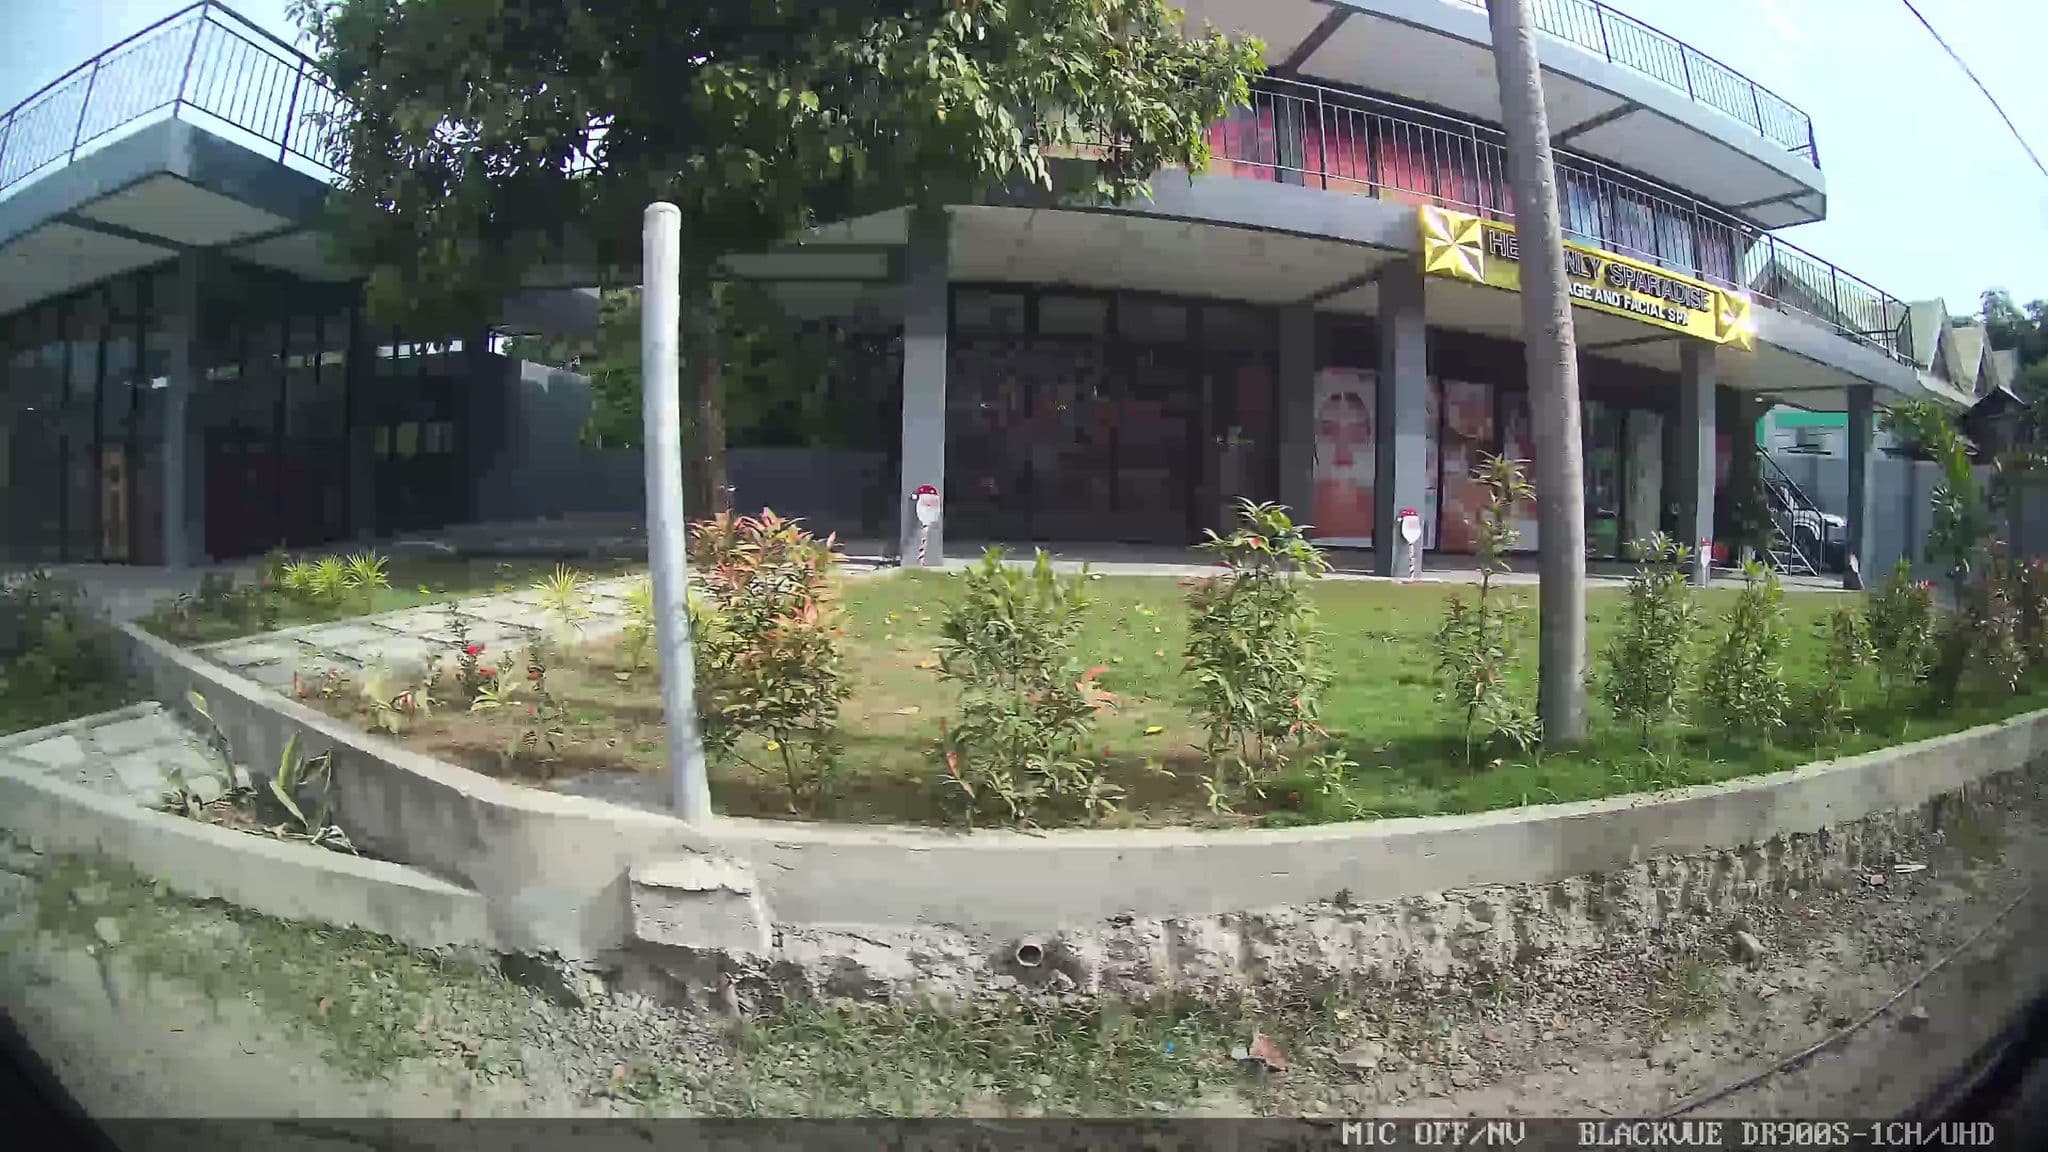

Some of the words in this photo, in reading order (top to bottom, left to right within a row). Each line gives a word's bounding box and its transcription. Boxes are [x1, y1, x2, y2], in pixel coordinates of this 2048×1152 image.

[1488, 229, 1602, 281] HENLY
[1607, 263, 1711, 313] SPARADISE
[1594, 288, 1621, 307] AND
[1624, 297, 1666, 318] FACIAL
[1668, 310, 1690, 327] SPA
